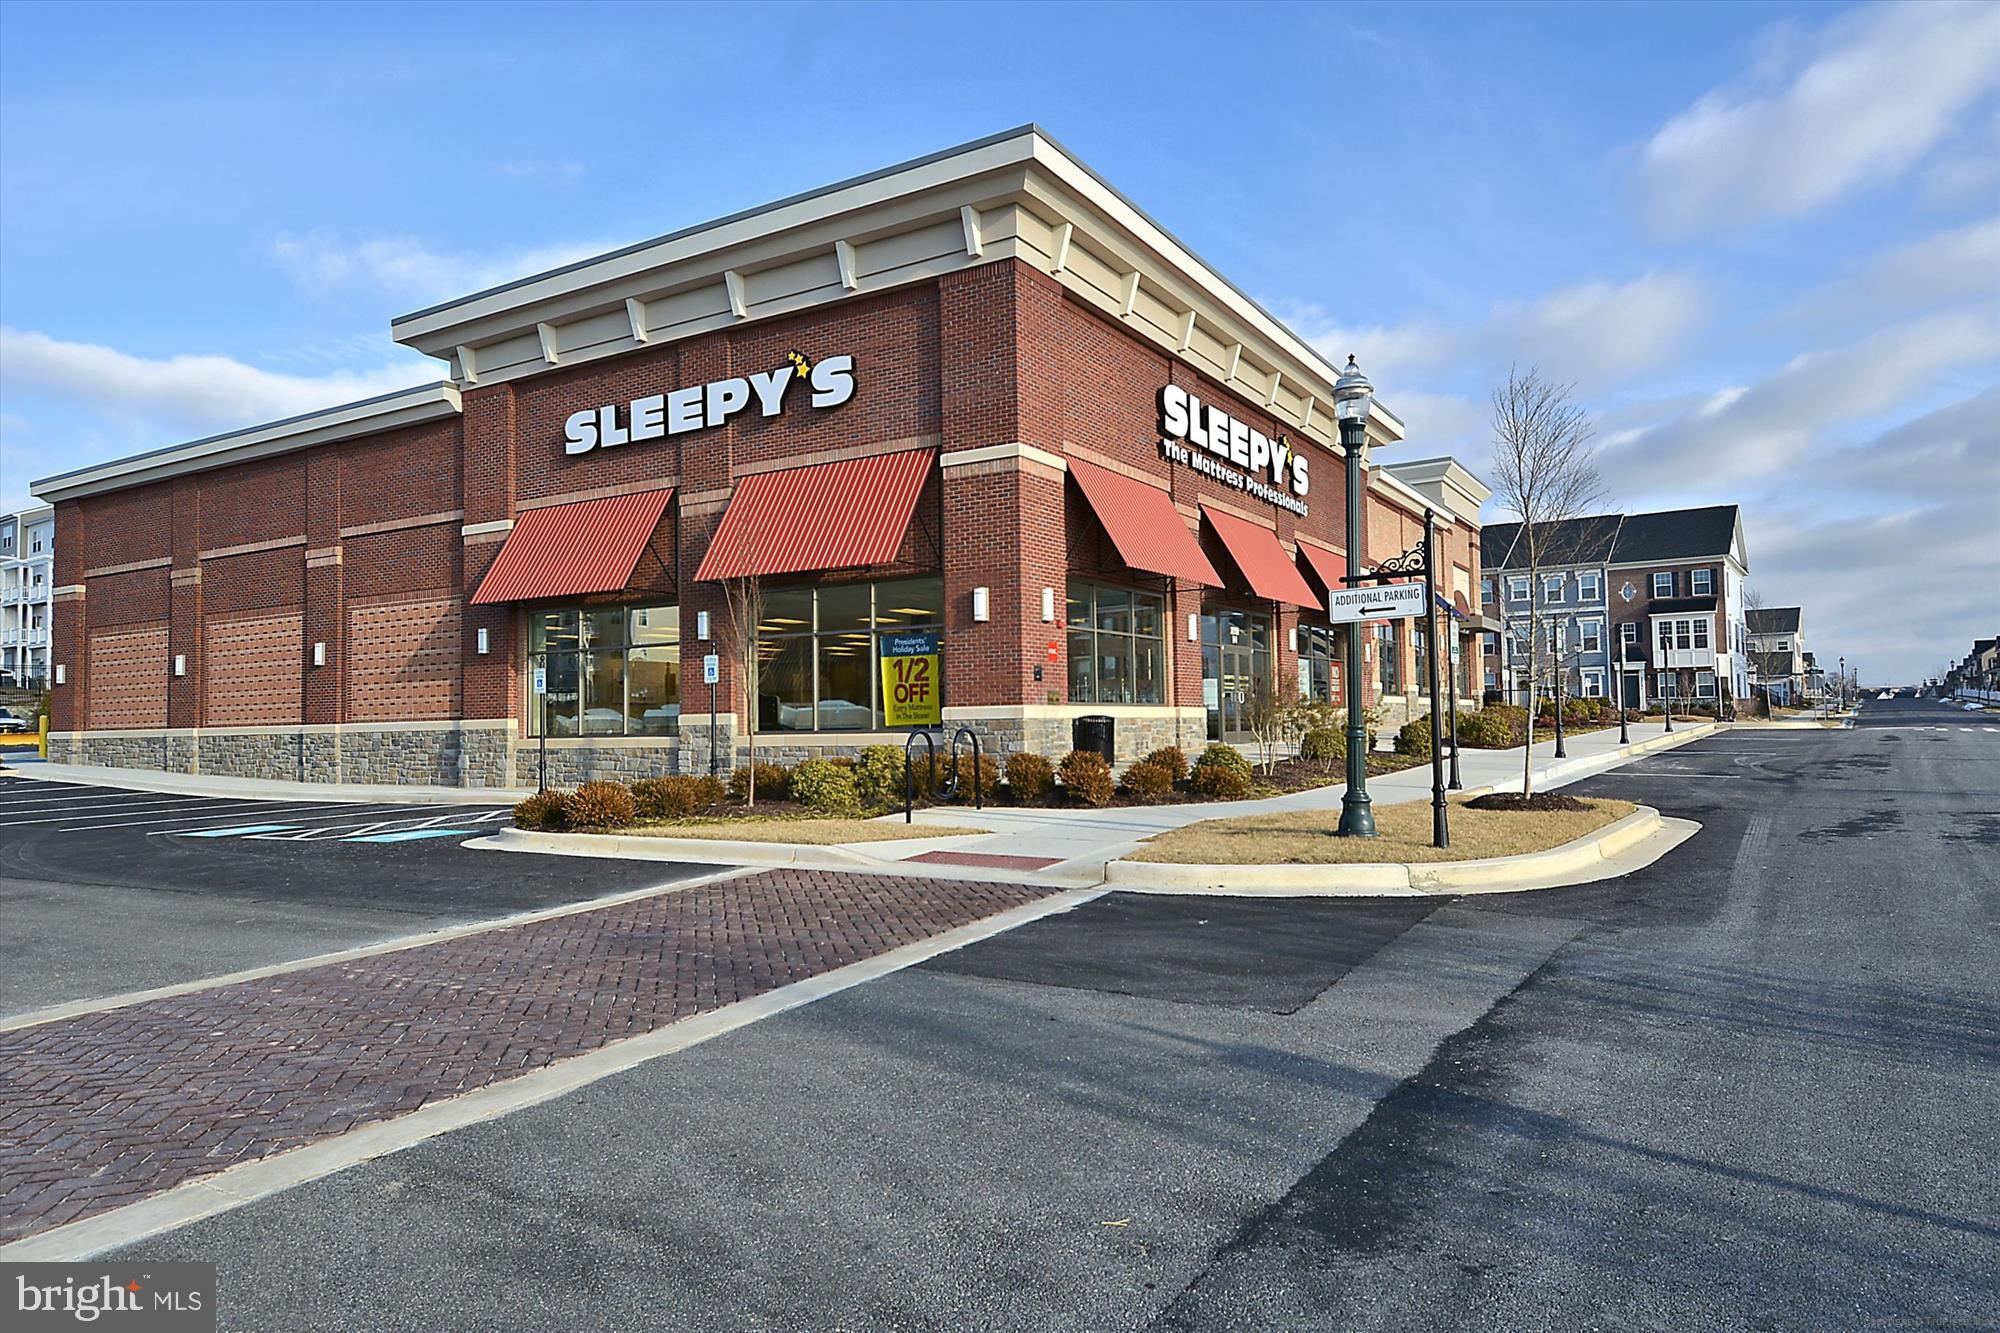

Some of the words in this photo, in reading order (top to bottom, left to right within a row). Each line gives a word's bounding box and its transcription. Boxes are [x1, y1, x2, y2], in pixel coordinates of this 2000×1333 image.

[565, 351, 855, 455] SLEEPY'S
[1162, 384, 1310, 496] SLEEPY'S
[1163, 438, 1189, 463] The
[1191, 451, 1244, 488] Mattress
[1246, 476, 1309, 517] Professionals
[1335, 591, 1382, 606] ADDITIONAL
[1384, 588, 1420, 602] PARKING
[892, 645, 914, 654] Holiday
[915, 644, 930, 652] Sale
[892, 657, 930, 683] 1/2
[894, 683, 930, 703] OFF
